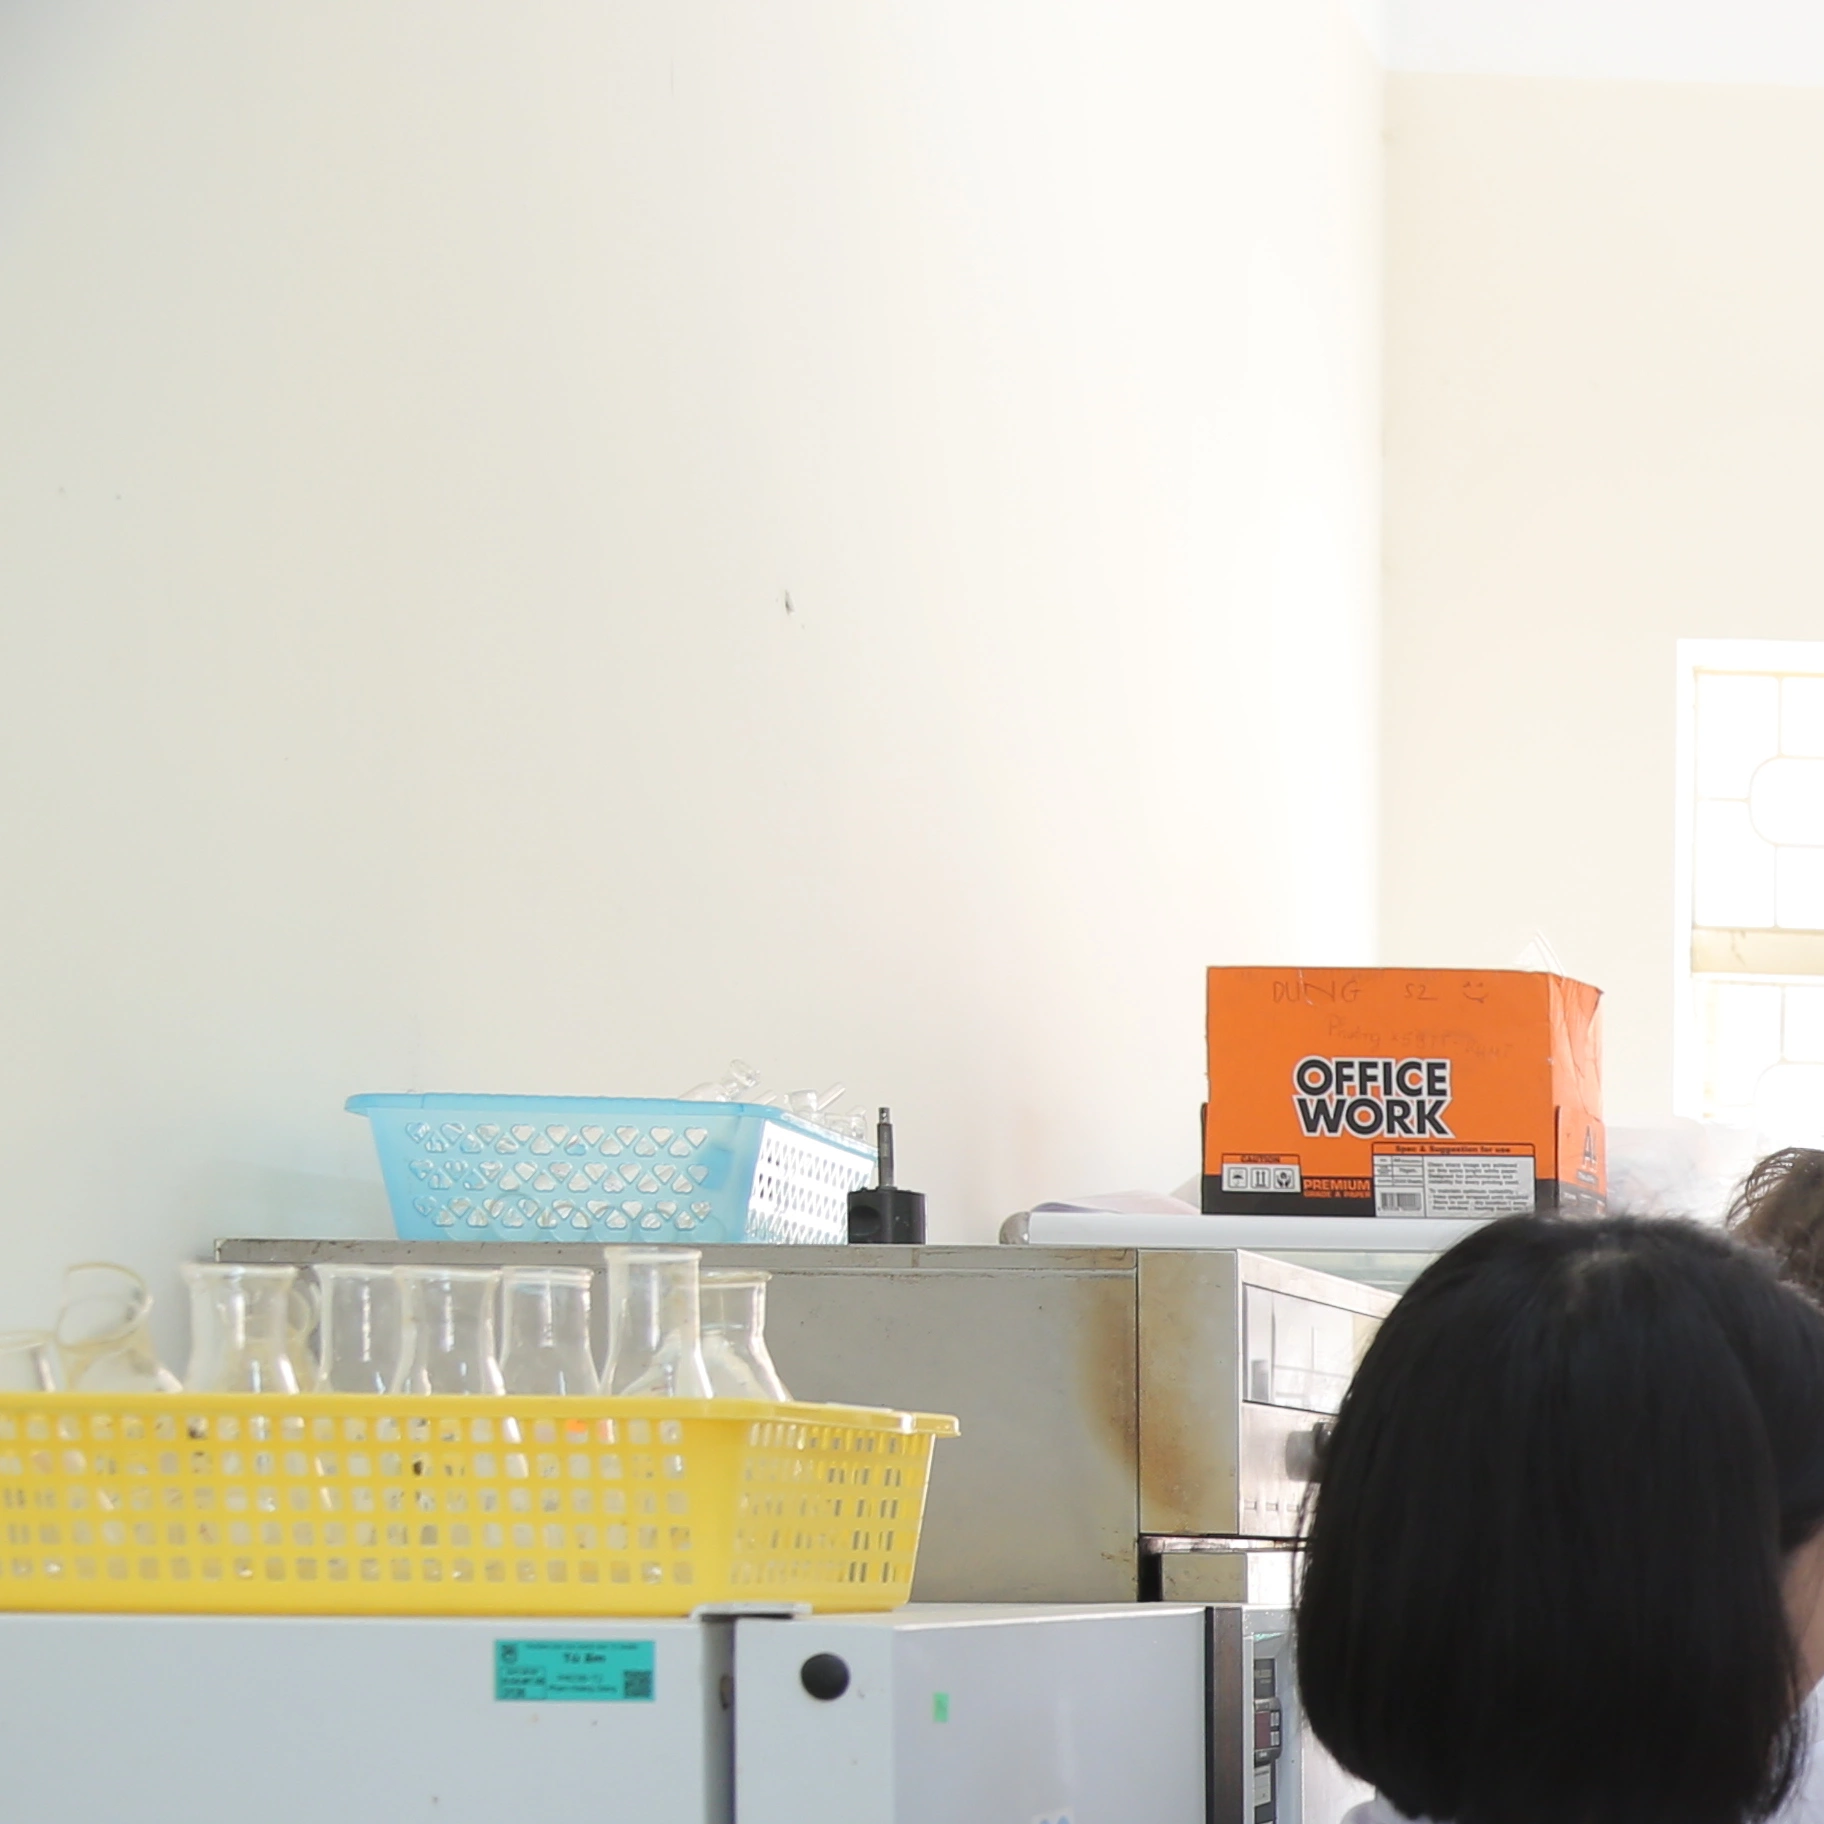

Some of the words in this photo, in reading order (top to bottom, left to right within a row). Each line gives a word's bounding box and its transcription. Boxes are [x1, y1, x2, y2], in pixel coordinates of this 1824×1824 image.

[1295, 1057, 1449, 1098] OFFICE
[1295, 1097, 1453, 1137] WORK
[1303, 1178, 1371, 1191] PREMIUM
